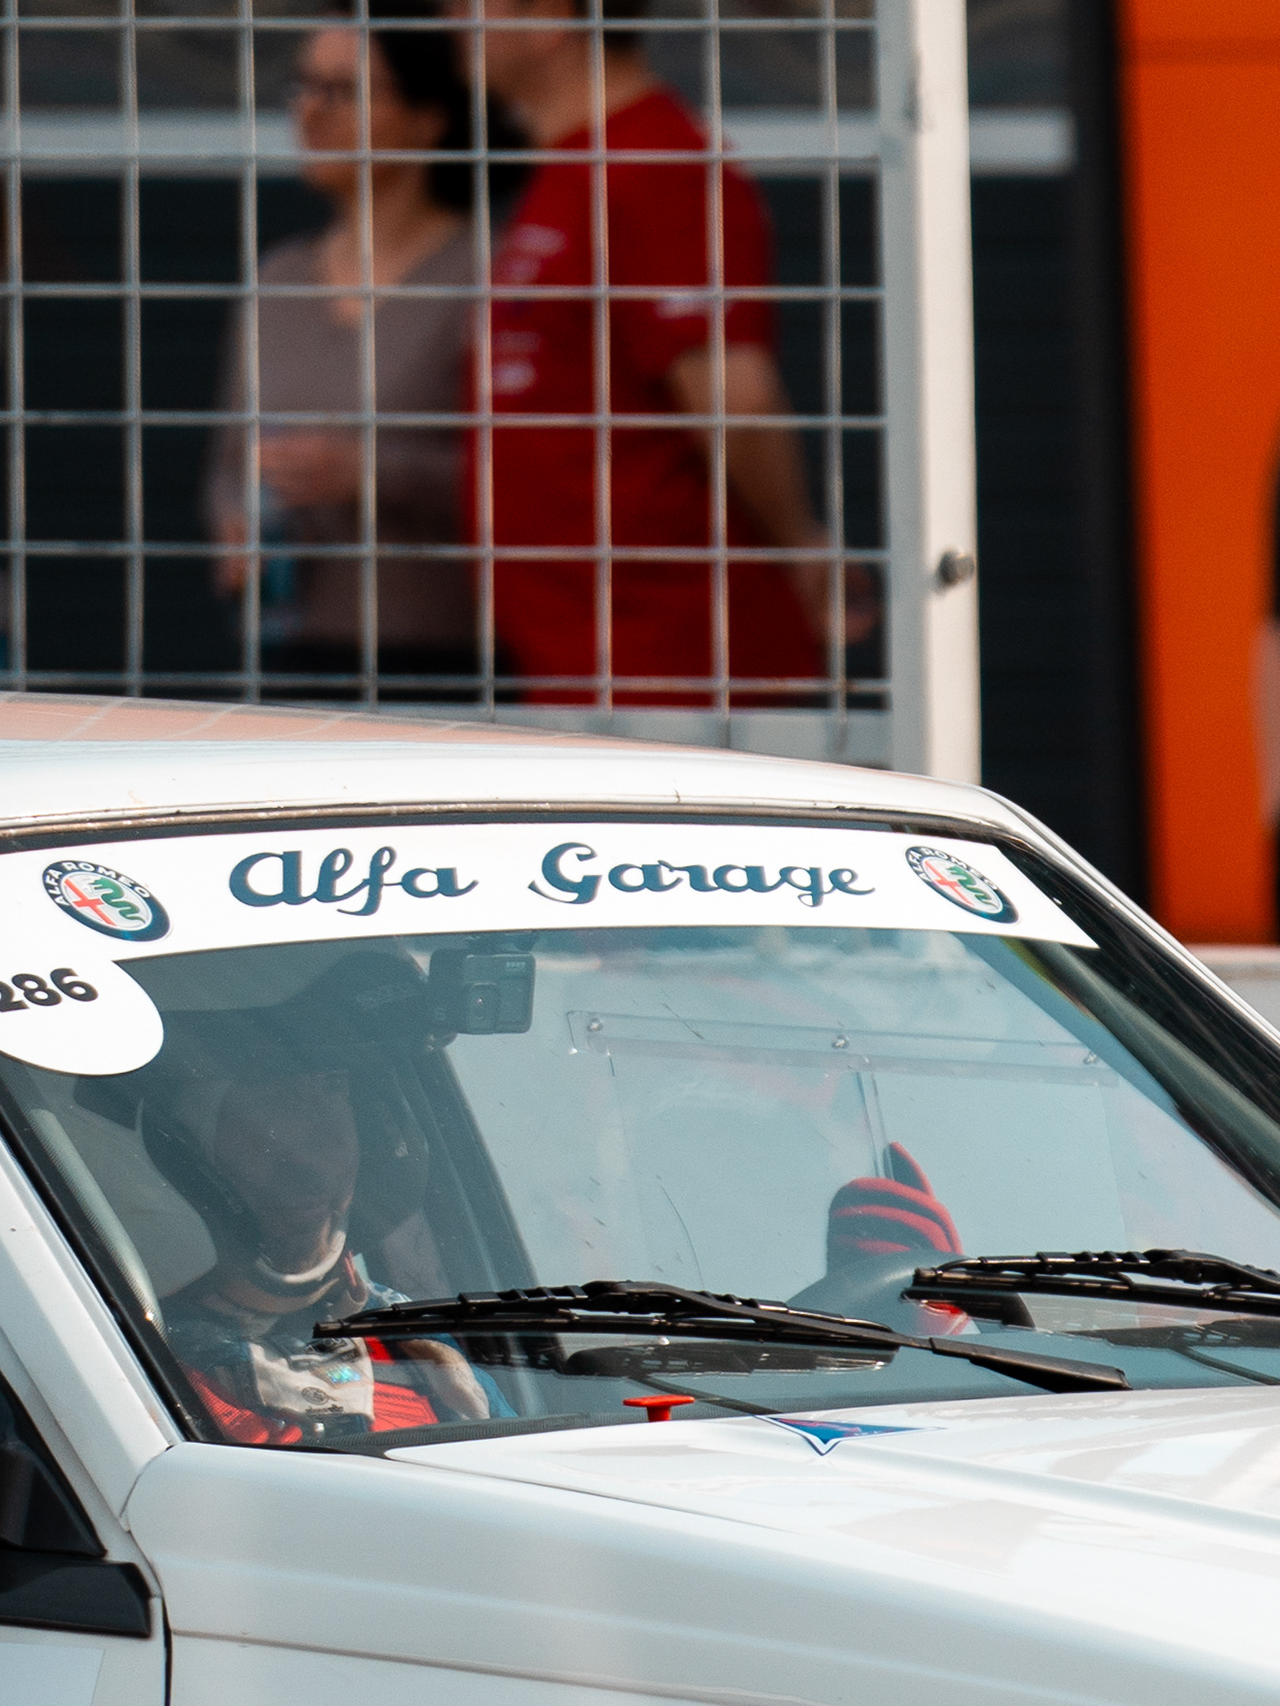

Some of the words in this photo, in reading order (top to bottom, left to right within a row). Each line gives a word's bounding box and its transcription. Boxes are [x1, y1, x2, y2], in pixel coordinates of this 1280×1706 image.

[46, 868, 69, 906] ALFA
[62, 861, 150, 898] ROMEO
[228, 846, 479, 916] Alfa
[527, 842, 876, 907] Garage
[921, 847, 998, 890] ROMEO
